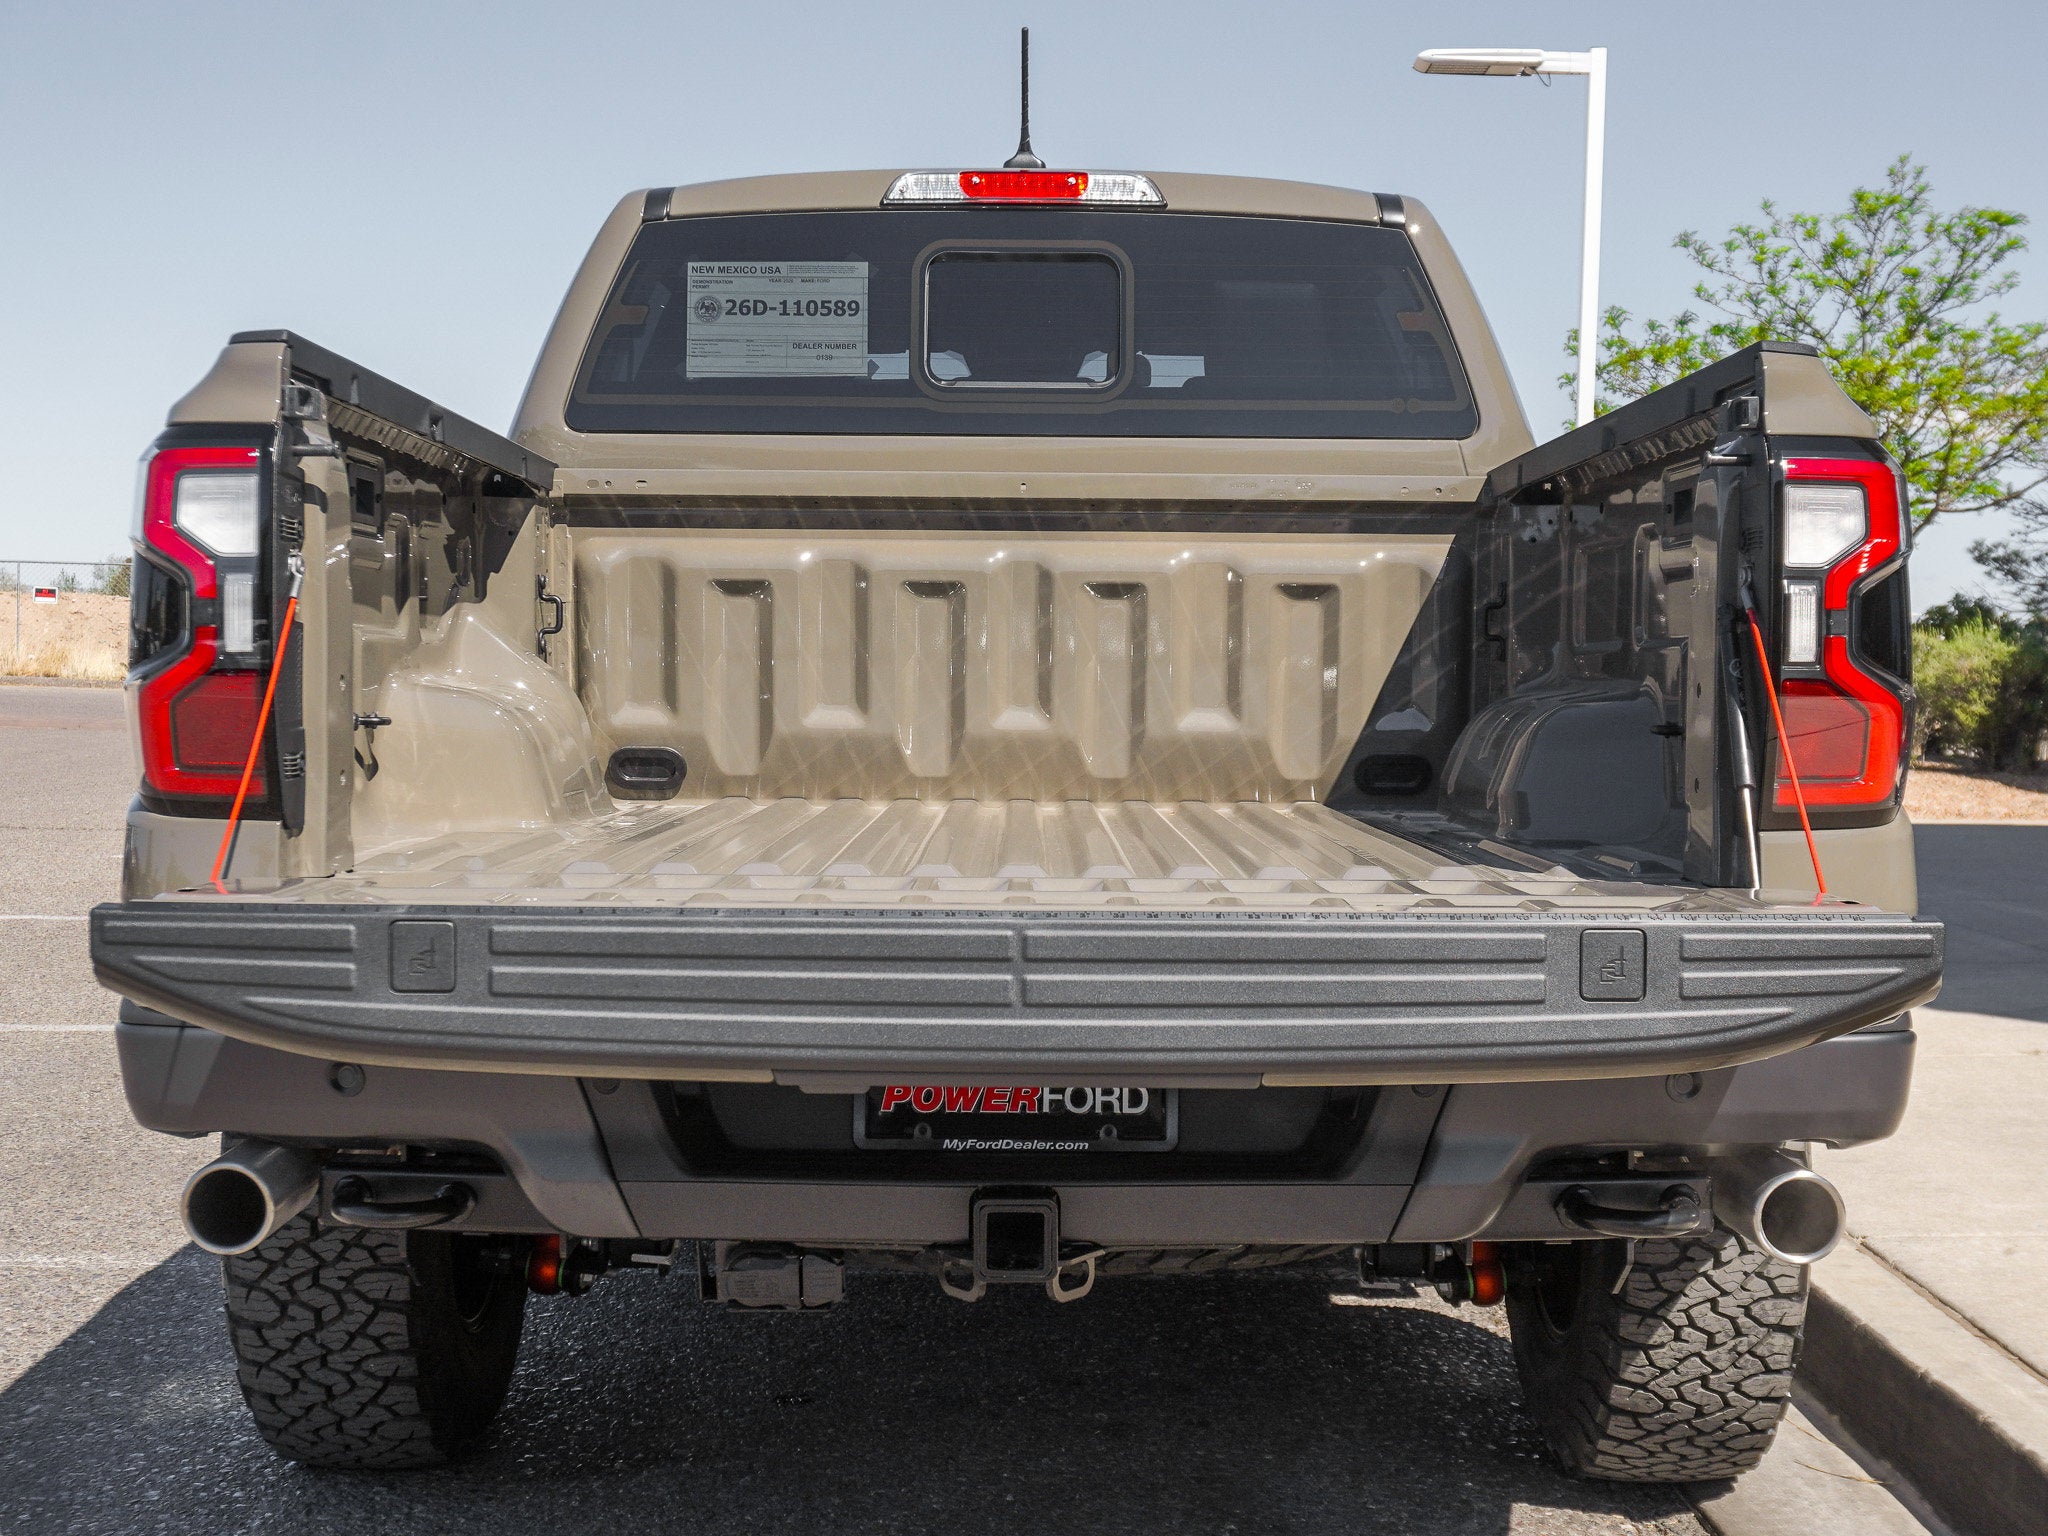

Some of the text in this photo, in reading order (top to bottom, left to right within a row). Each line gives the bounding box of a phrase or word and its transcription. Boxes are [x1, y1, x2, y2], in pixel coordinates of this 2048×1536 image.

[691, 265, 715, 274] NEW
[717, 265, 758, 275] MEXICO
[760, 266, 782, 275] USA
[724, 298, 861, 317] 26D-110589
[792, 342, 823, 350] DEALER
[942, 1138, 1090, 1151] MyFordDealer.com
